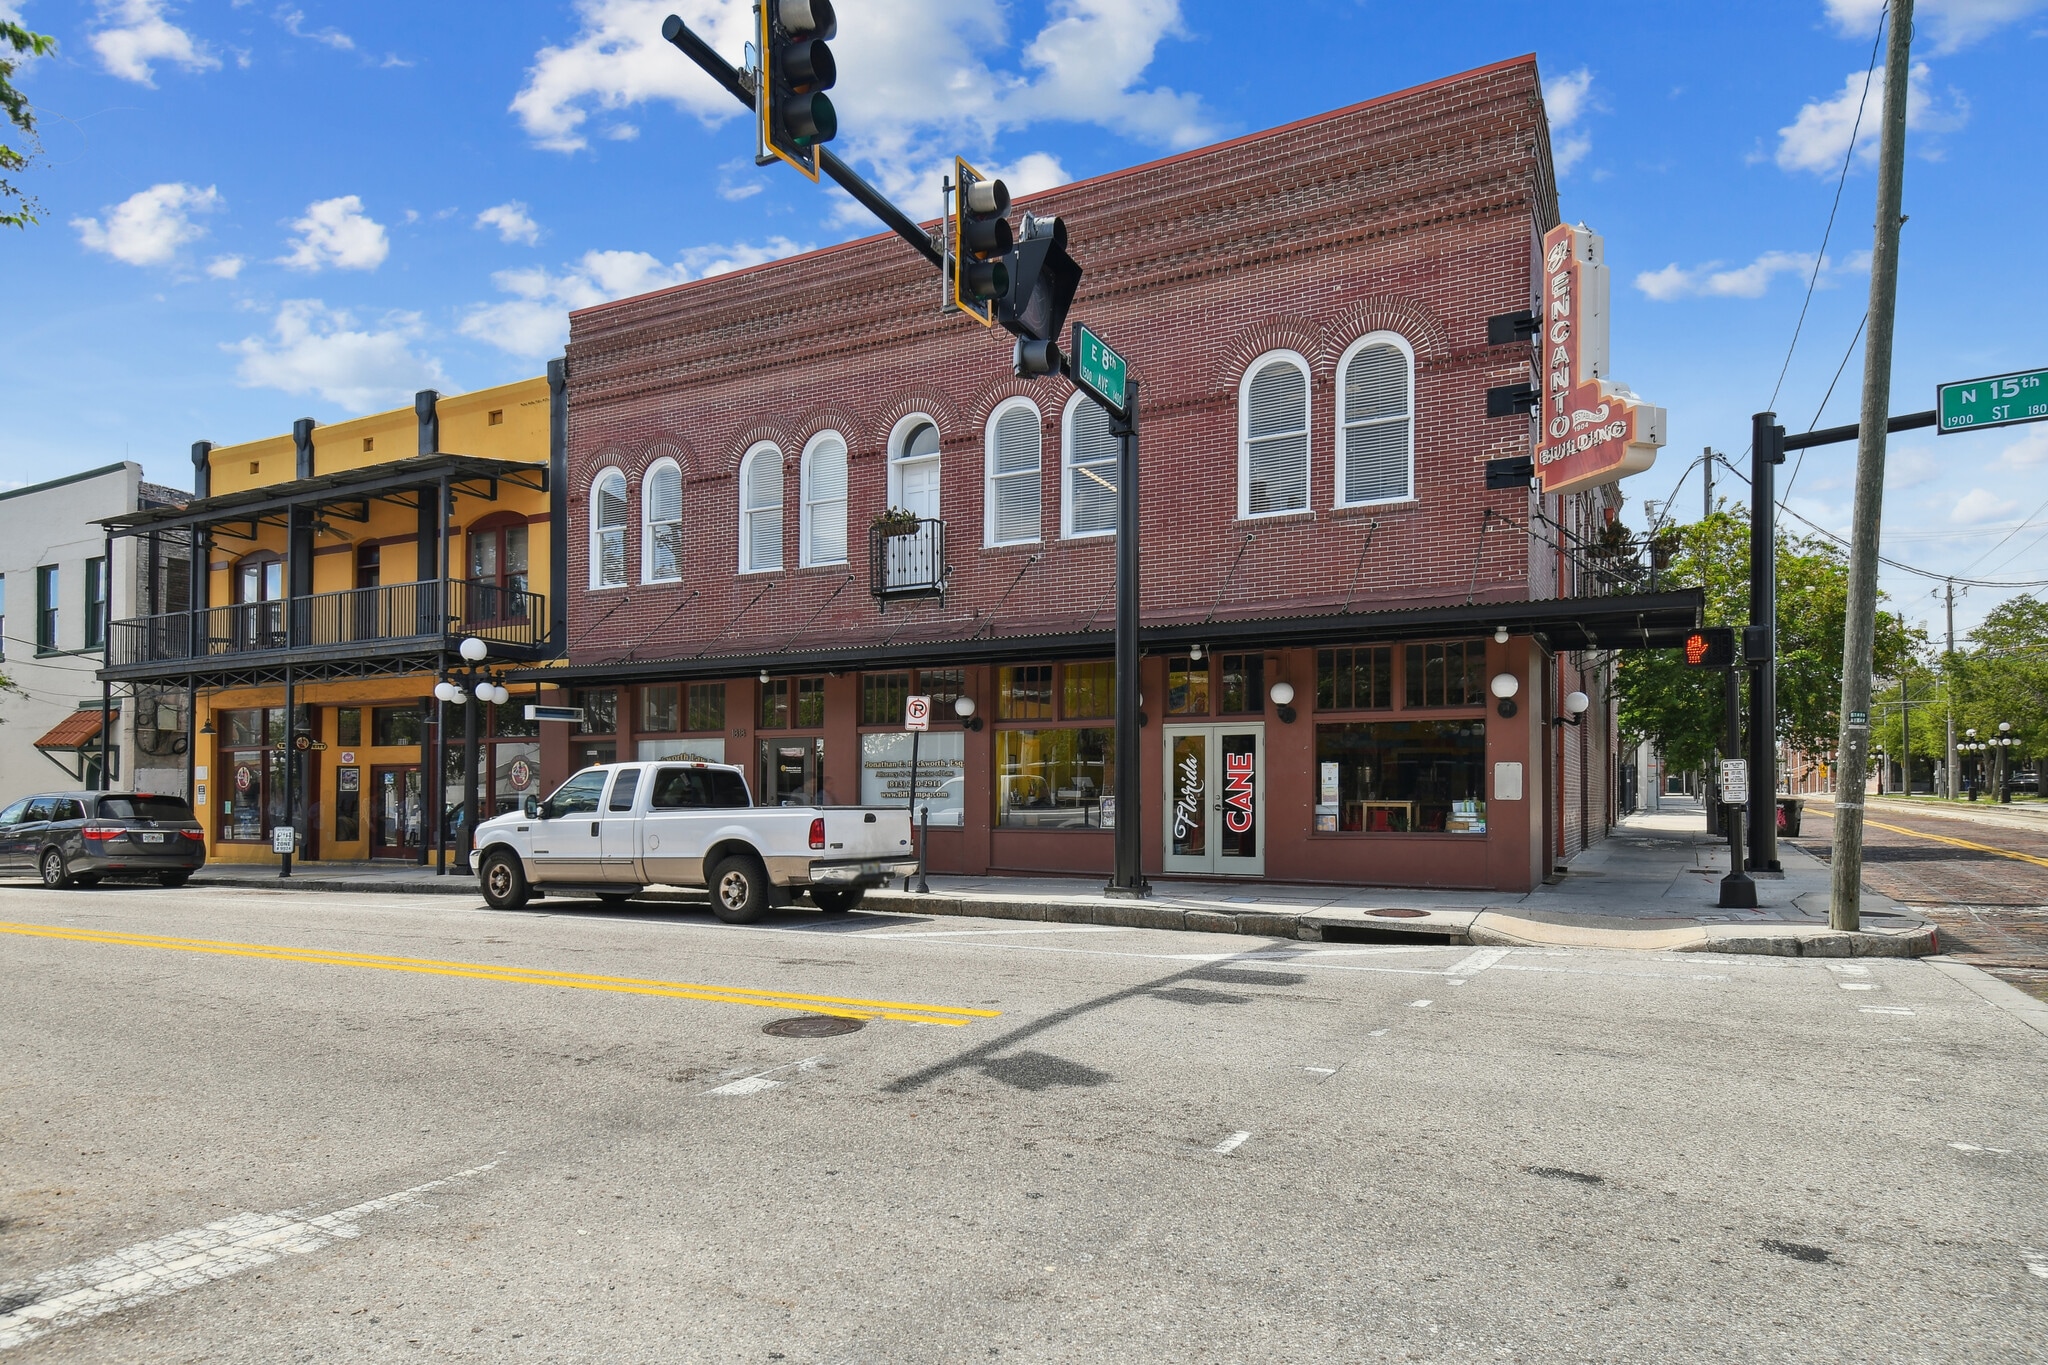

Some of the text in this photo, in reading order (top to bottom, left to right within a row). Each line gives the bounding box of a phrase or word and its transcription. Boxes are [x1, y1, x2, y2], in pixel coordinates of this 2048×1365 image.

[1091, 343, 1117, 370] E 8th
[1549, 273, 1571, 438] ENCANTO
[1082, 365, 1093, 382] 1500
[1097, 374, 1109, 395] AVE
[1961, 376, 2040, 404] N 15th
[1574, 411, 1606, 422] ESTABLISHED
[1574, 422, 1589, 432] 1904
[1948, 404, 2048, 427] 1900 ST 180
[1539, 421, 1627, 466] BUILDING
[731, 728, 746, 739] 1818
[865, 760, 897, 769] Jonathan
[906, 780, 942, 788] 20-2911
[1174, 753, 1205, 838] Florida
[1225, 753, 1254, 832] CANE
